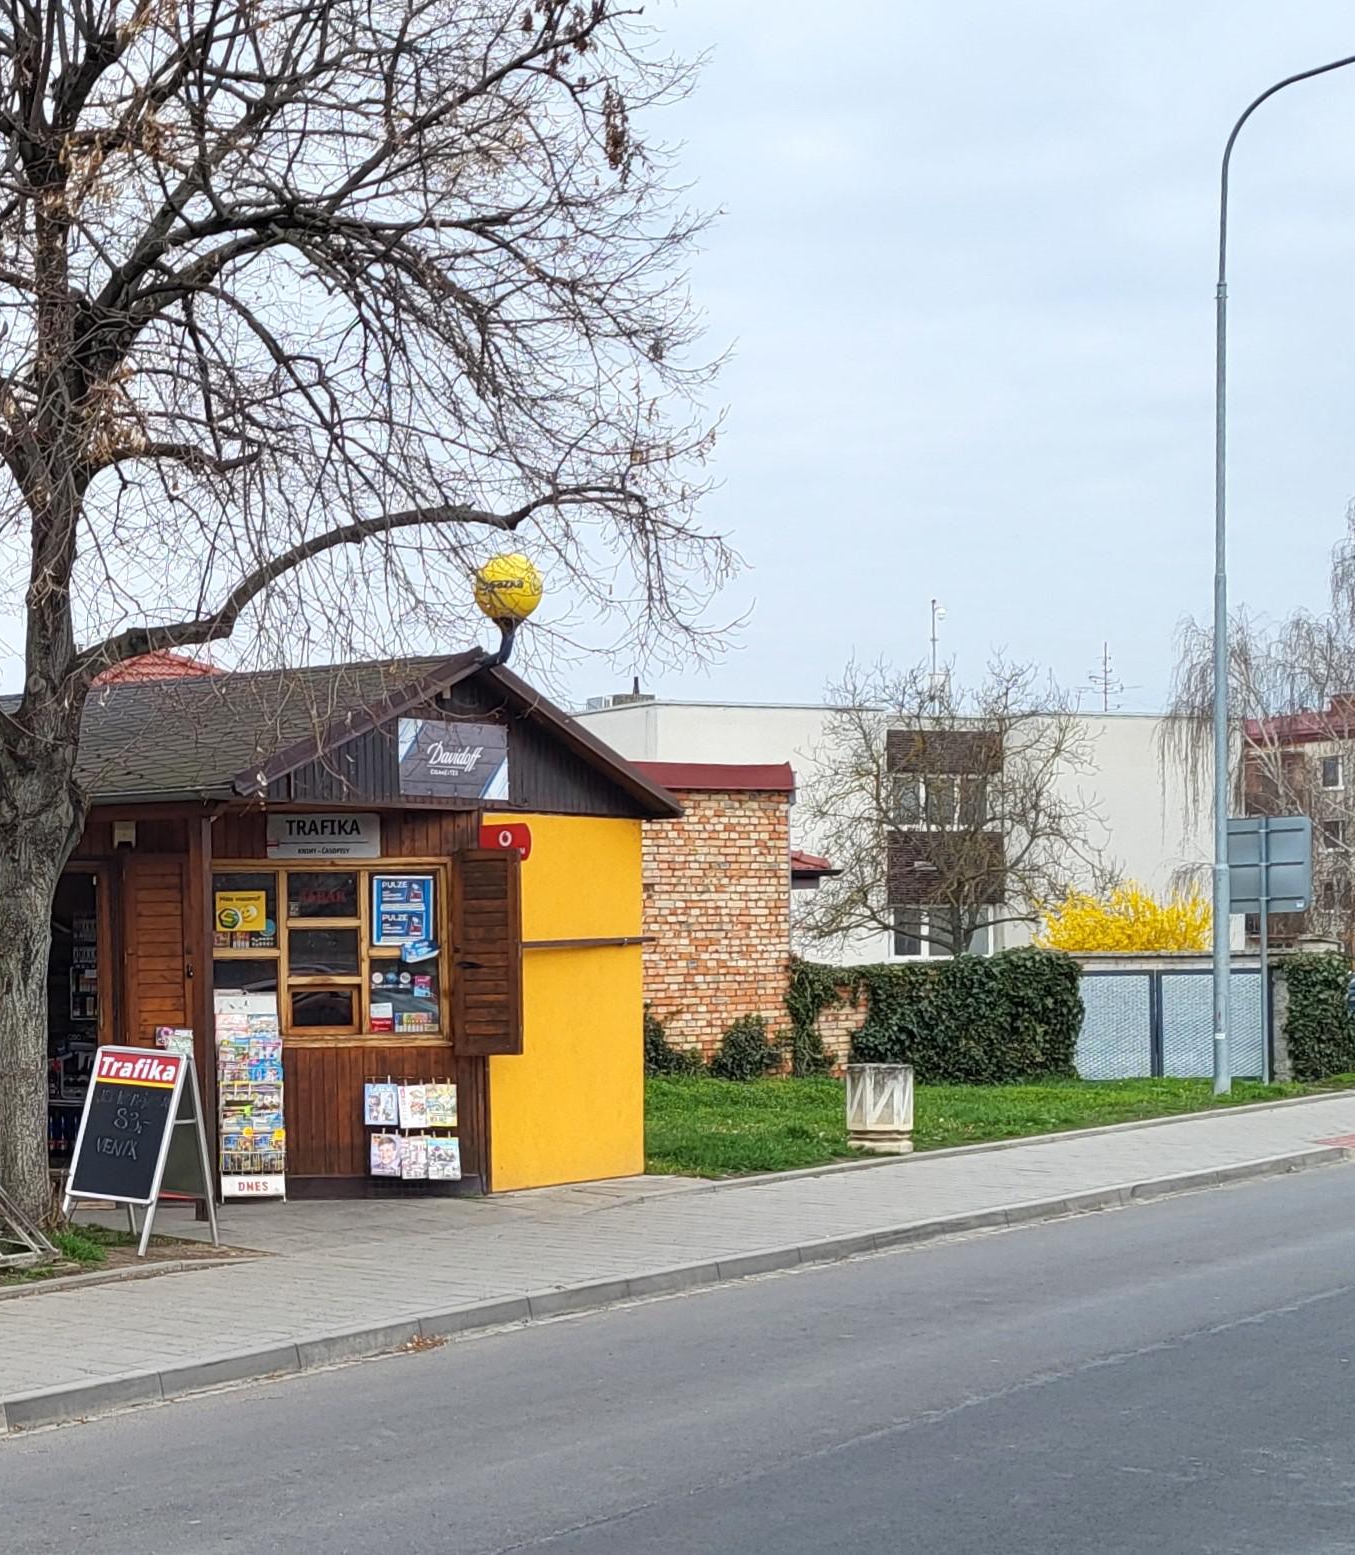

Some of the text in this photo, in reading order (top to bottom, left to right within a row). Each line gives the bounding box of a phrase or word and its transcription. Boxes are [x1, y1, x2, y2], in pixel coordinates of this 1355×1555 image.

[427, 740, 484, 773] Davidoff
[285, 819, 361, 836] TRAFIKA
[101, 1056, 176, 1081] Trafika
[237, 1181, 269, 1192] DNES
